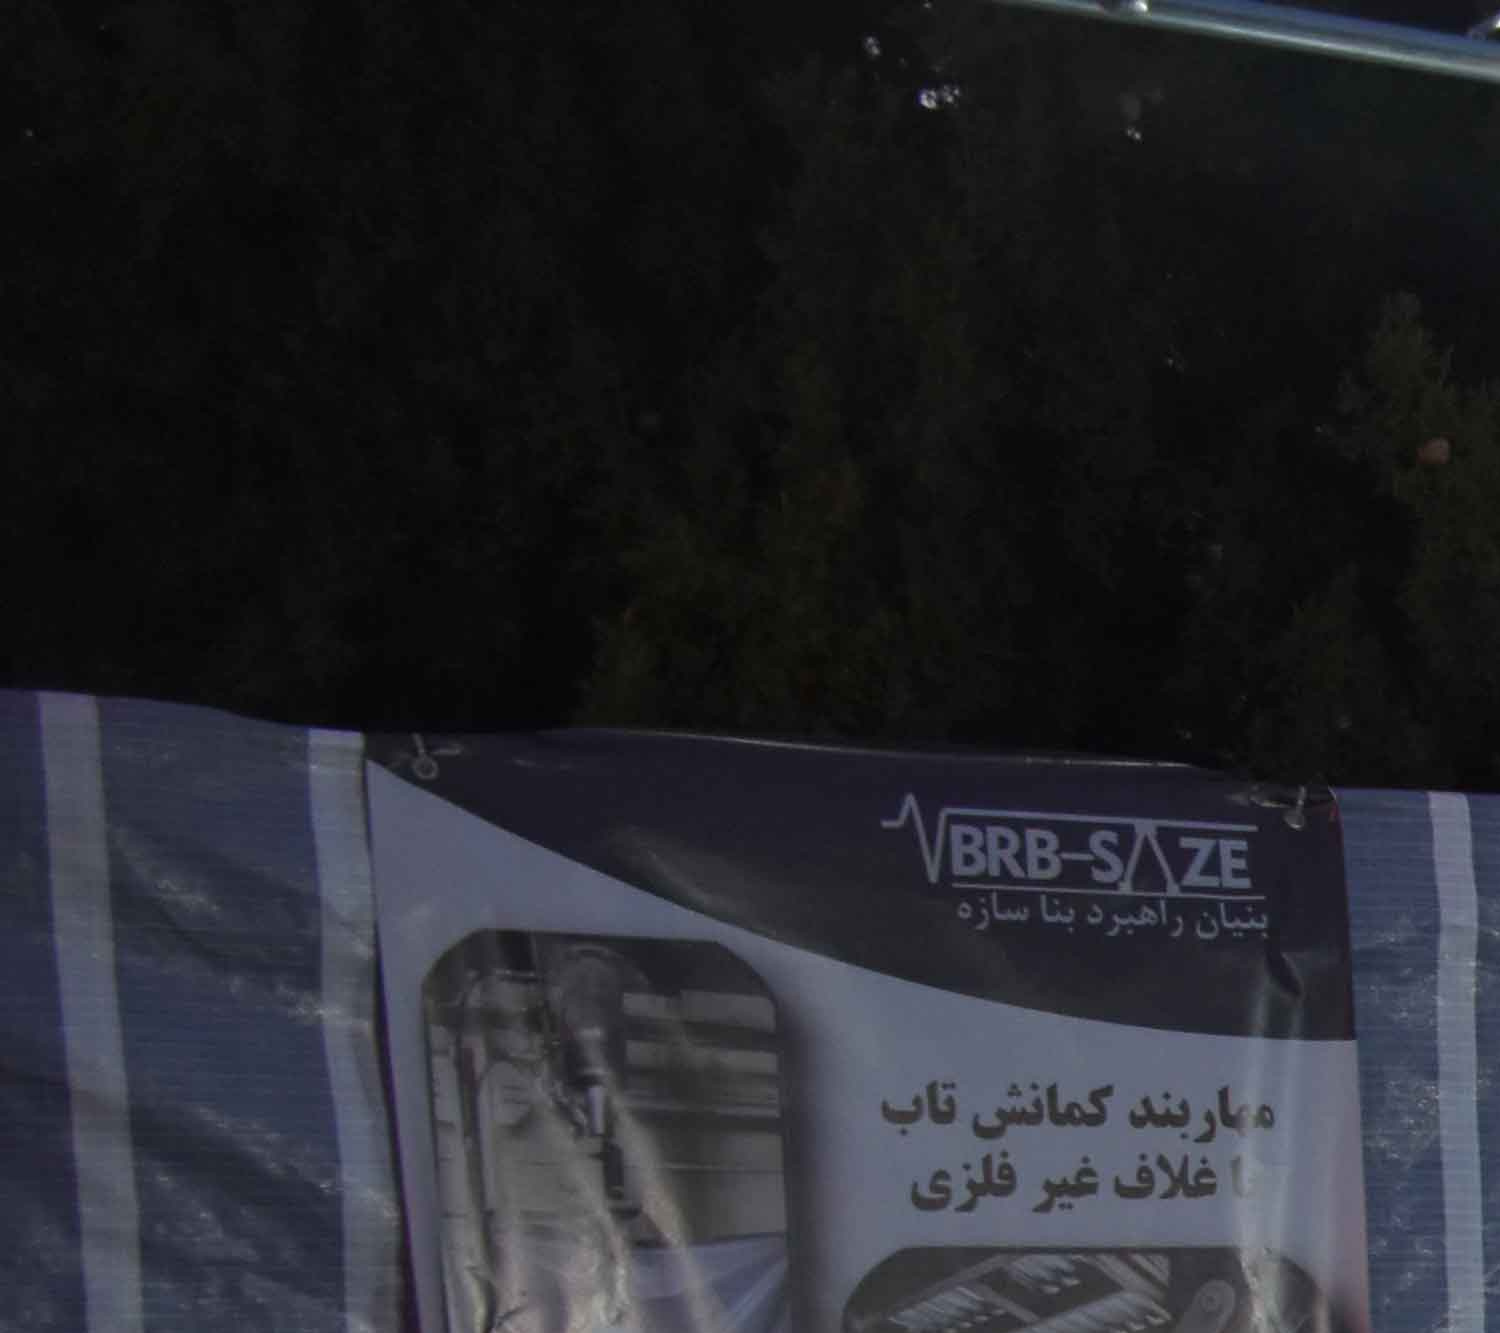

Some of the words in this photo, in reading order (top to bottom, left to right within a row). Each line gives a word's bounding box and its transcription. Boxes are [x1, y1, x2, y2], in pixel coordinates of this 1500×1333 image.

[955, 889, 1031, 931] سازه
[1039, 894, 1077, 933] بنا
[1086, 897, 1184, 936] راهبرد
[1194, 901, 1269, 938] بنیان
[881, 1079, 957, 1137] تاب
[971, 1081, 1116, 1140] کمانش
[1128, 1084, 1277, 1143] مهاربند
[909, 1148, 1018, 1212] فلزی
[1032, 1153, 1099, 1212] غیر
[1111, 1151, 1218, 1200] غلاف
